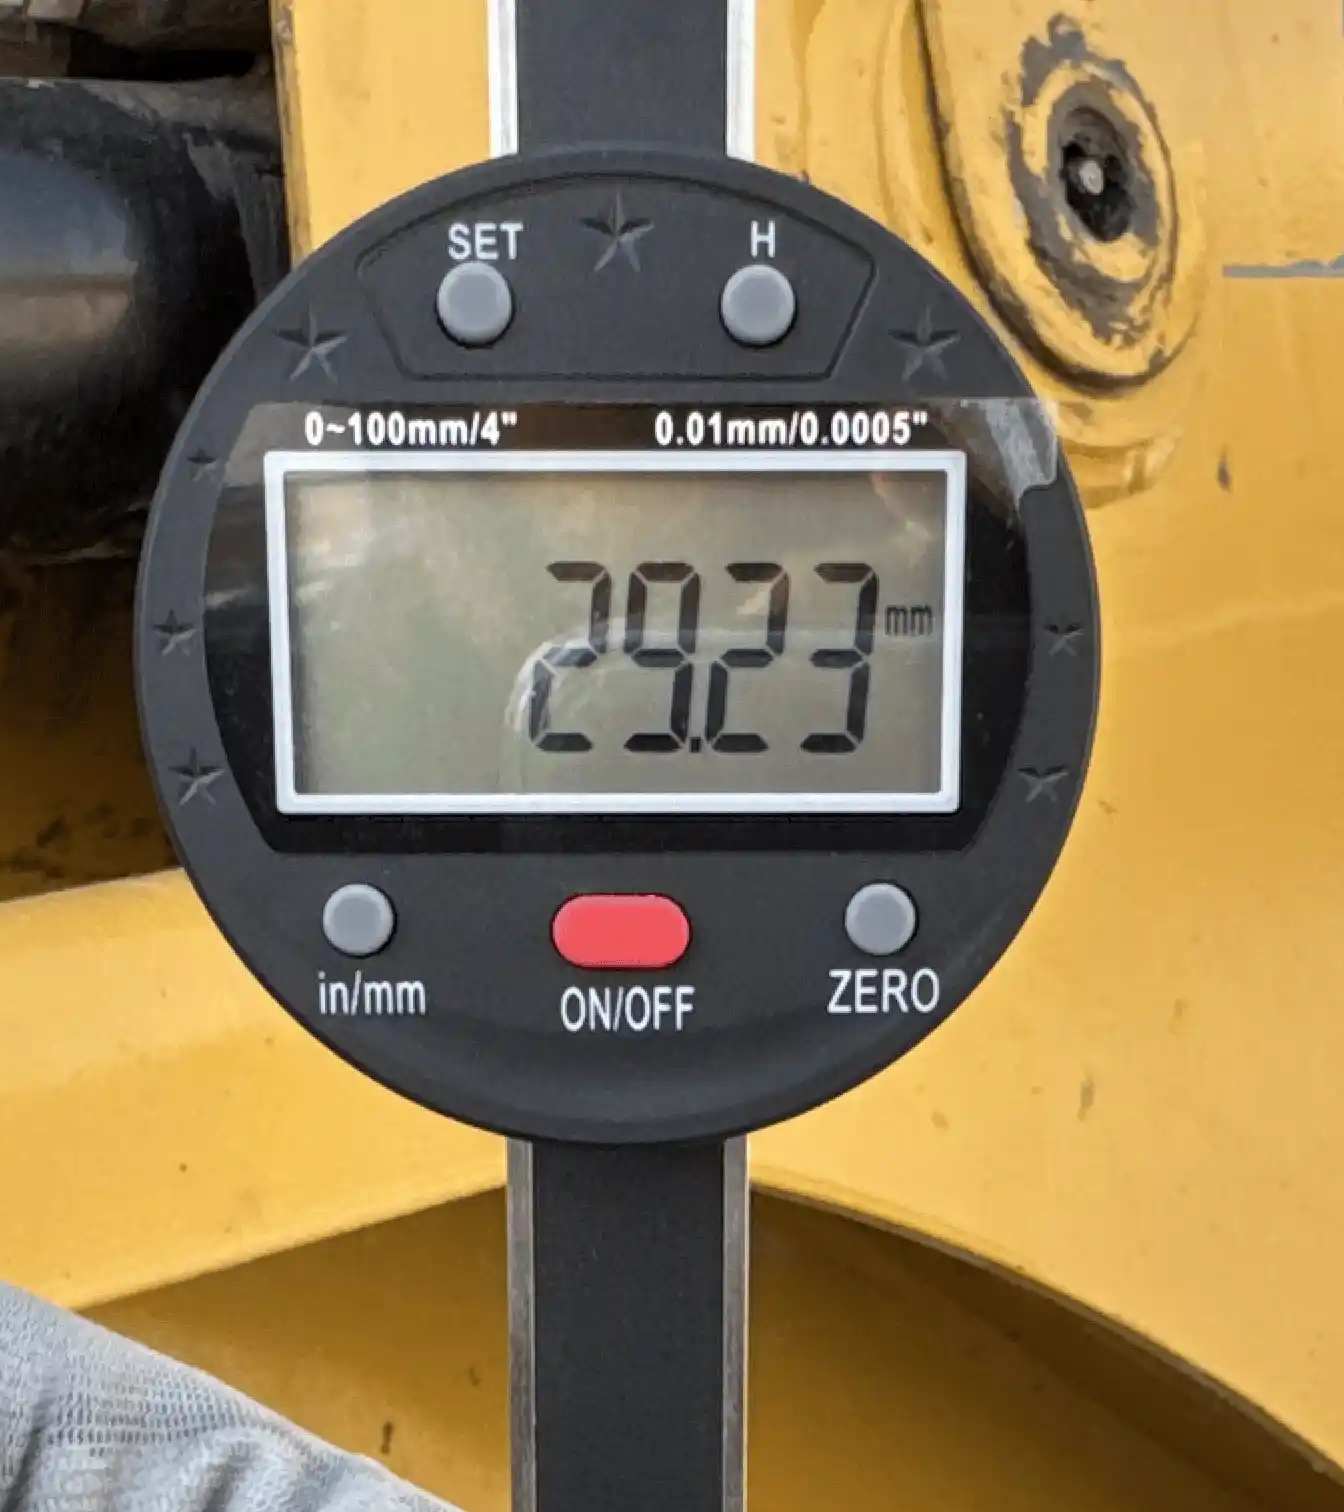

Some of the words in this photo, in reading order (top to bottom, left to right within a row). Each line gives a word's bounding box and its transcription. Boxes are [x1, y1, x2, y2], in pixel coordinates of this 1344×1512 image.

[446, 222, 524, 261] SET
[749, 222, 777, 257] H
[304, 411, 518, 447] 0~100mm/4"
[654, 411, 928, 447] 0.01mm/0.0005"
[527, 561, 880, 754] 29.23
[884, 603, 934, 637] mm
[318, 972, 427, 1016] in/mm
[559, 985, 695, 1034] ON/OFF
[827, 969, 941, 1014] ZERO
